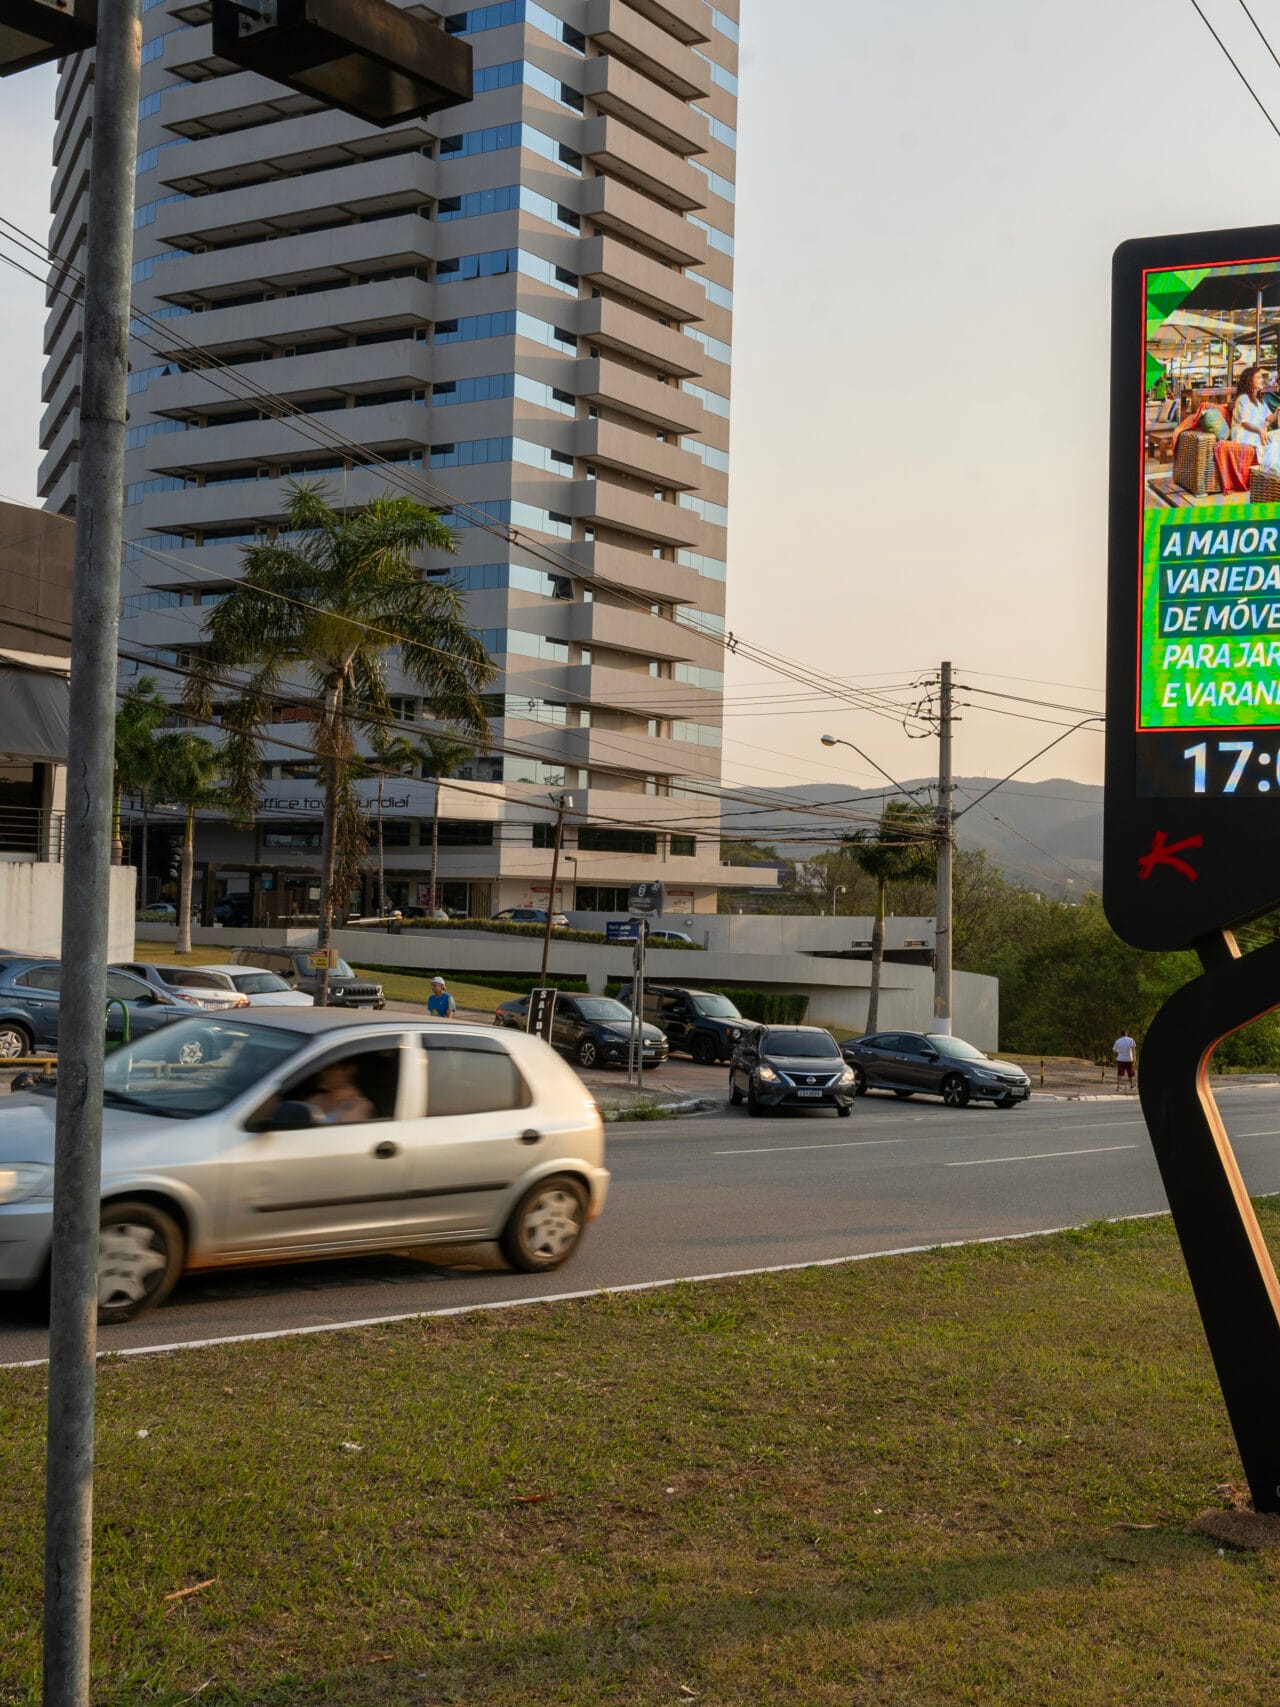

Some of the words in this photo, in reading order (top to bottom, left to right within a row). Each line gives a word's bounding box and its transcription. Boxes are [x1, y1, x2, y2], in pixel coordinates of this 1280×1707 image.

[1163, 532, 1181, 556] A
[1186, 527, 1278, 555] MAIOR
[1163, 606, 1201, 632] DE
[1163, 645, 1230, 669] PARA
[1162, 683, 1180, 707] E
[259, 797, 299, 809] office
